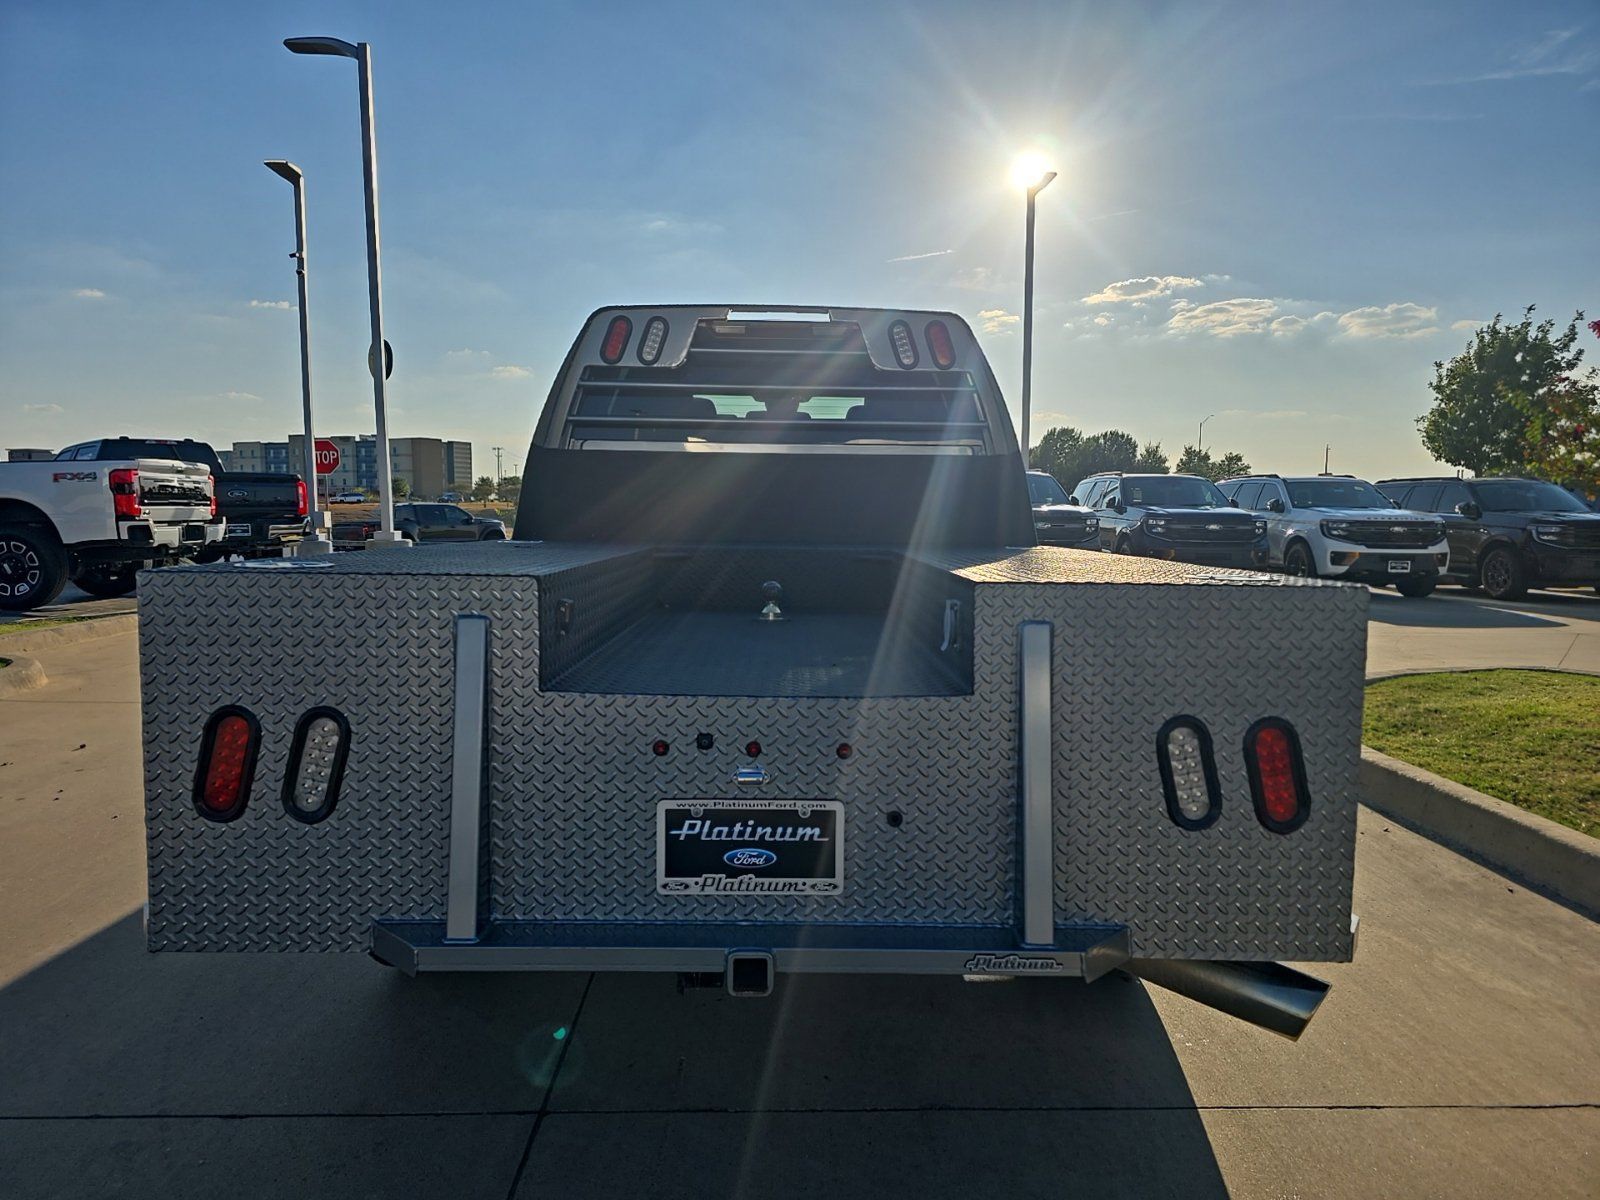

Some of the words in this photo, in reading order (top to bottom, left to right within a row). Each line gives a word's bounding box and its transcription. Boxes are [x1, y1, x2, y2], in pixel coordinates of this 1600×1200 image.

[315, 450, 337, 464] TOP
[53, 471, 97, 482] FX4
[676, 801, 827, 809] www.PlatinumFord.com
[669, 819, 829, 842] Platinum
[733, 851, 766, 865] Ford
[700, 876, 805, 892] Platinum
[966, 954, 1063, 972] Platinum
